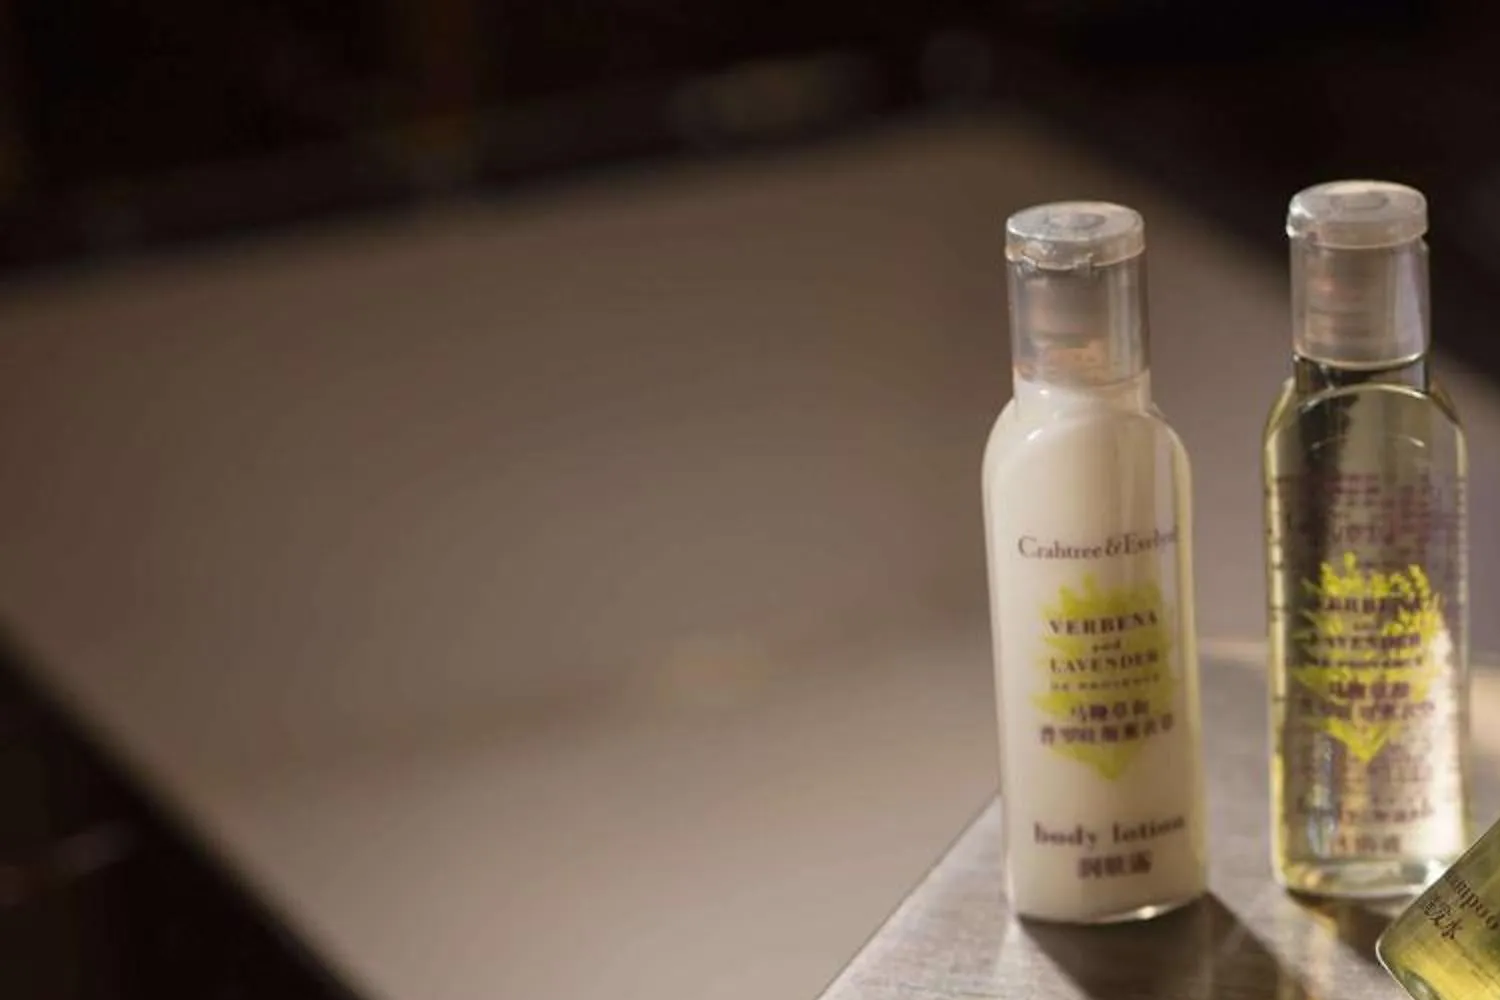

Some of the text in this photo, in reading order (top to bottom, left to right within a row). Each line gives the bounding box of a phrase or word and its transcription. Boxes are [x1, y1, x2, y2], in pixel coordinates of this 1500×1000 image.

[1050, 609, 1158, 635] VERBENA
[1050, 649, 1159, 674] LAVENDER
[1033, 815, 1186, 851] body lotion
